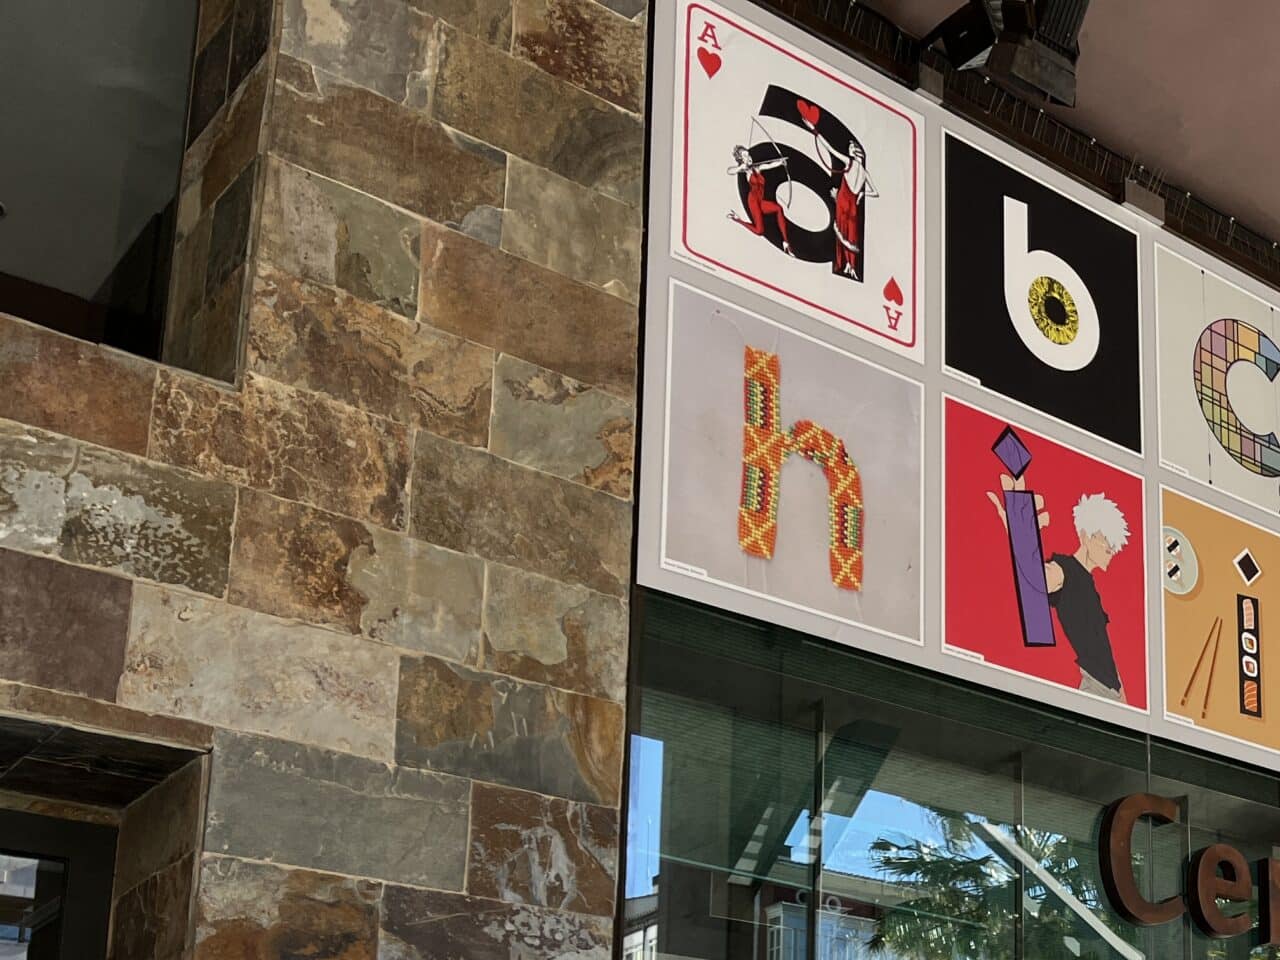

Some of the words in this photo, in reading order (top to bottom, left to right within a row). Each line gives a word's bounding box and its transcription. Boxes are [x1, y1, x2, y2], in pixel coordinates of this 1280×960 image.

[698, 21, 721, 50] A
[1003, 196, 1100, 371] b
[738, 345, 864, 592] h
